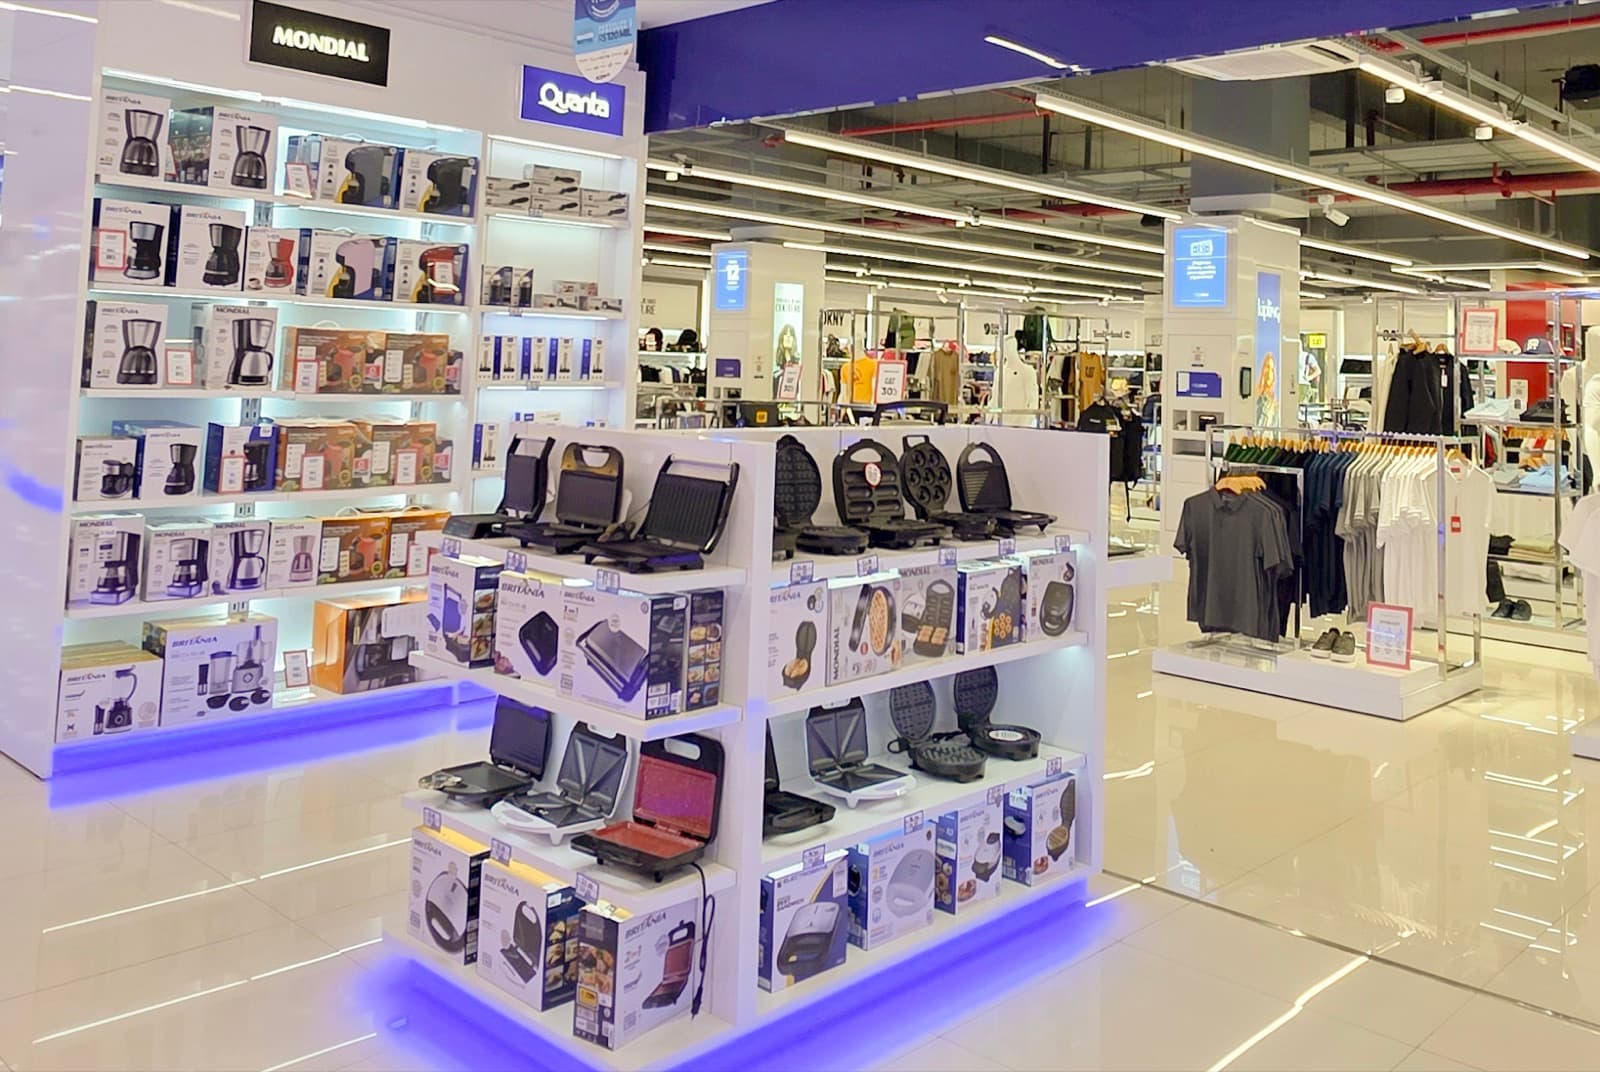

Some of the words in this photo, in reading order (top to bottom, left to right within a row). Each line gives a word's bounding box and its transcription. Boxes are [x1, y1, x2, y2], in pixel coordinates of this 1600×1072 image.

[272, 25, 370, 63] MONDIAL
[538, 82, 610, 119] Quanta
[833, 627, 841, 681] MONDIAL
